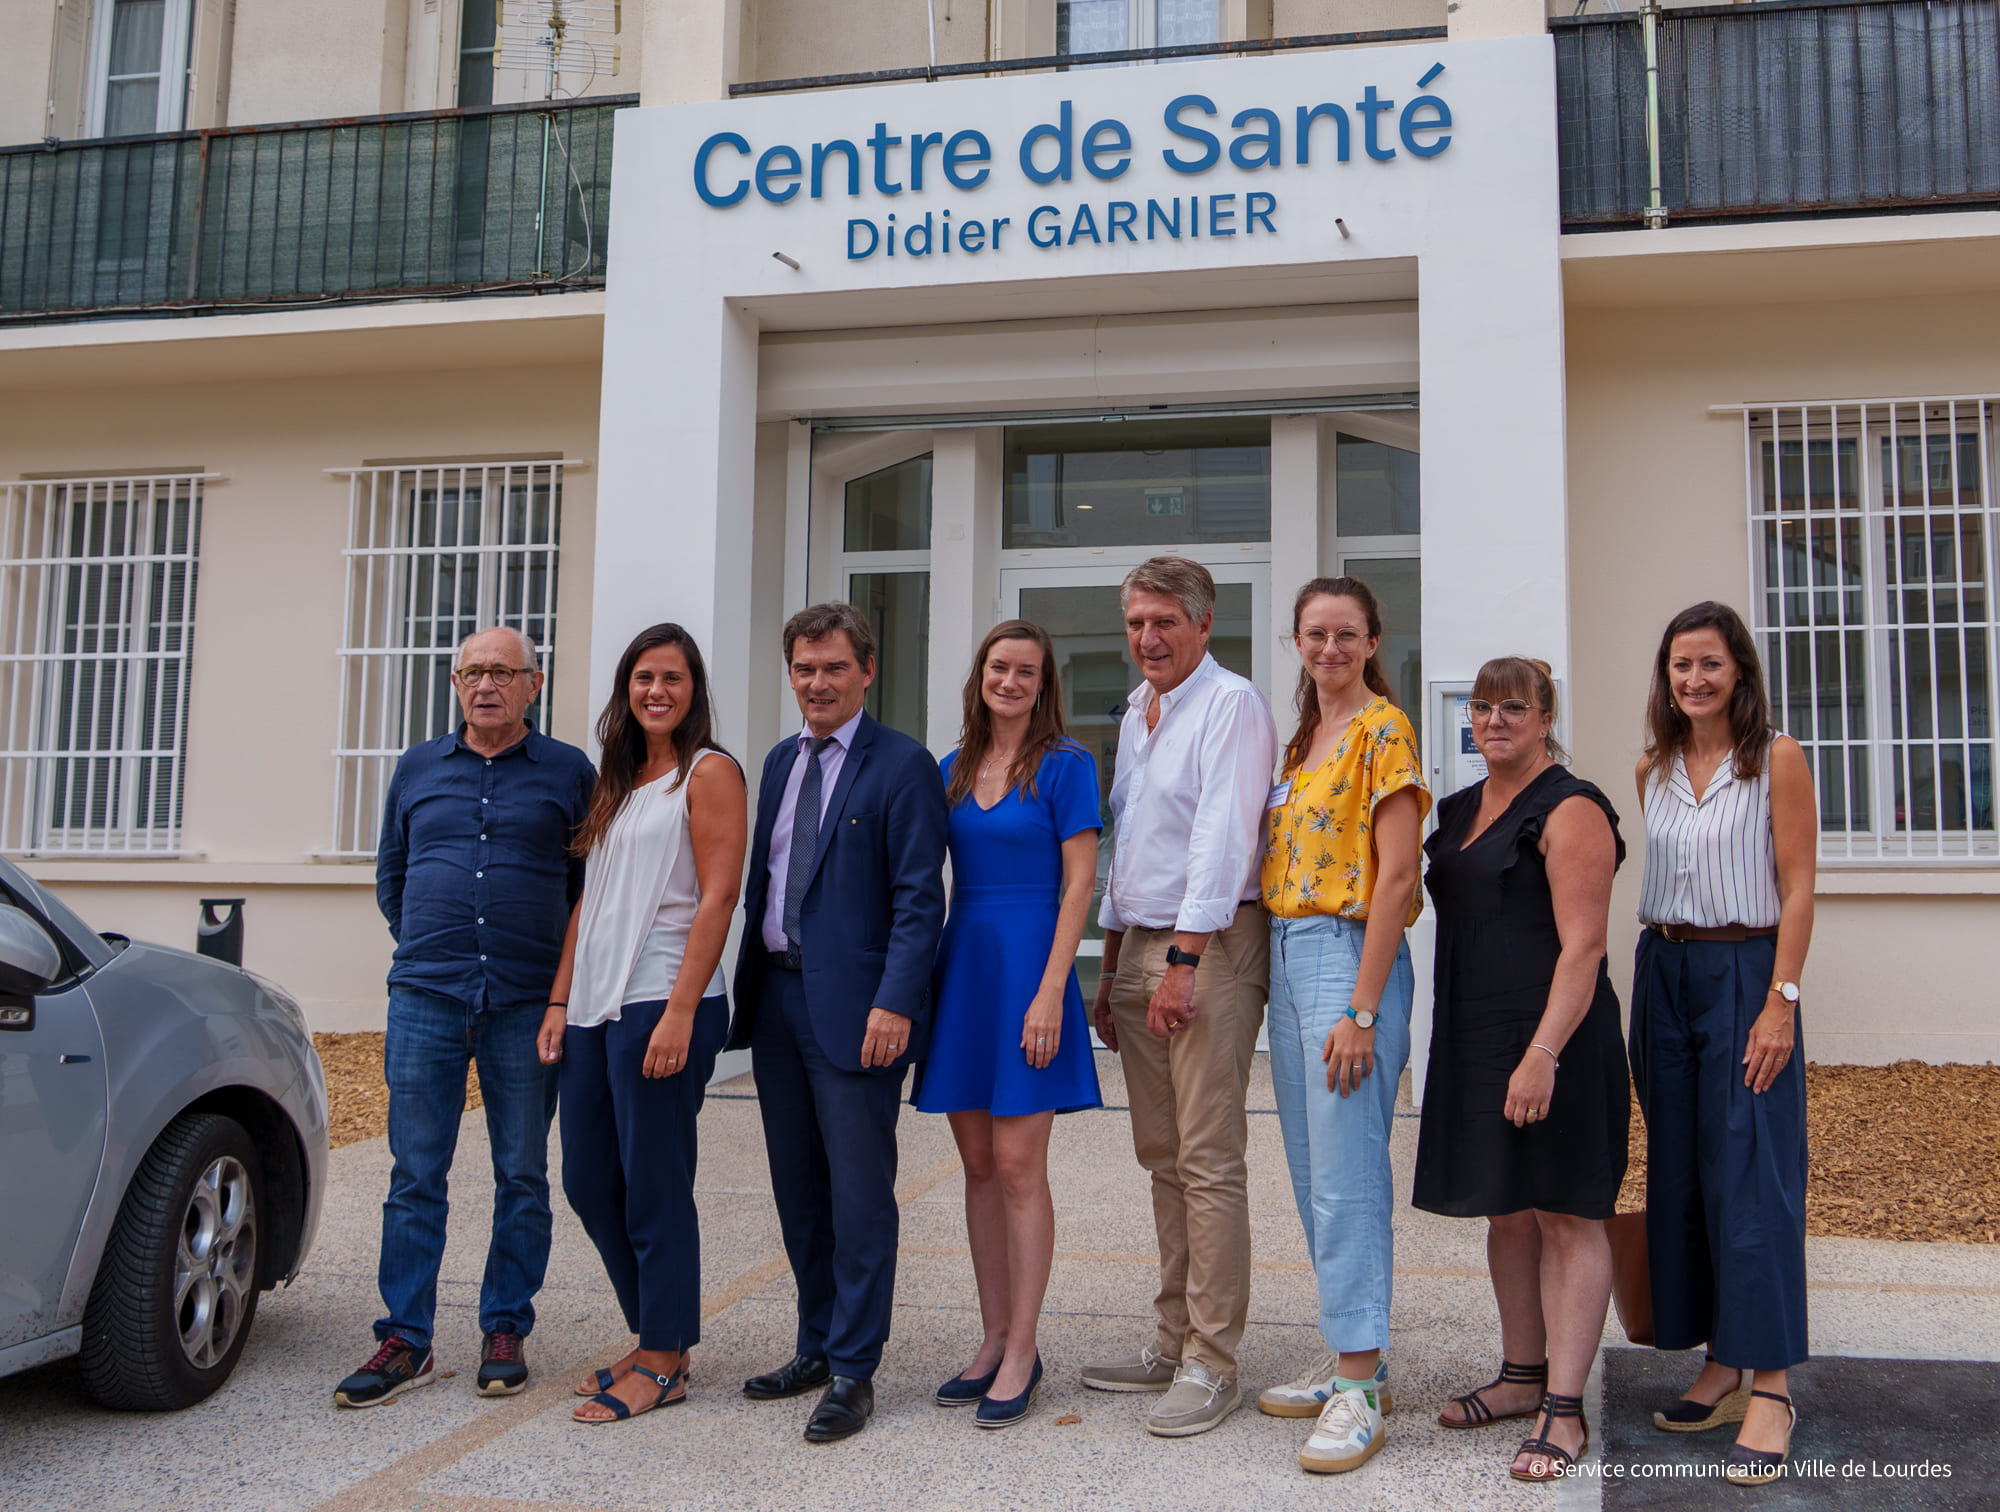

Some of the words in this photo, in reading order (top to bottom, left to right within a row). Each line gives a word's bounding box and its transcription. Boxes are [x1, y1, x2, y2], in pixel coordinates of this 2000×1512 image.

[693, 122, 992, 208] Centre
[1018, 99, 1132, 184] de
[1161, 61, 1453, 174] Santé
[847, 208, 1011, 260] Didier
[1027, 191, 1277, 249] GARNIER
